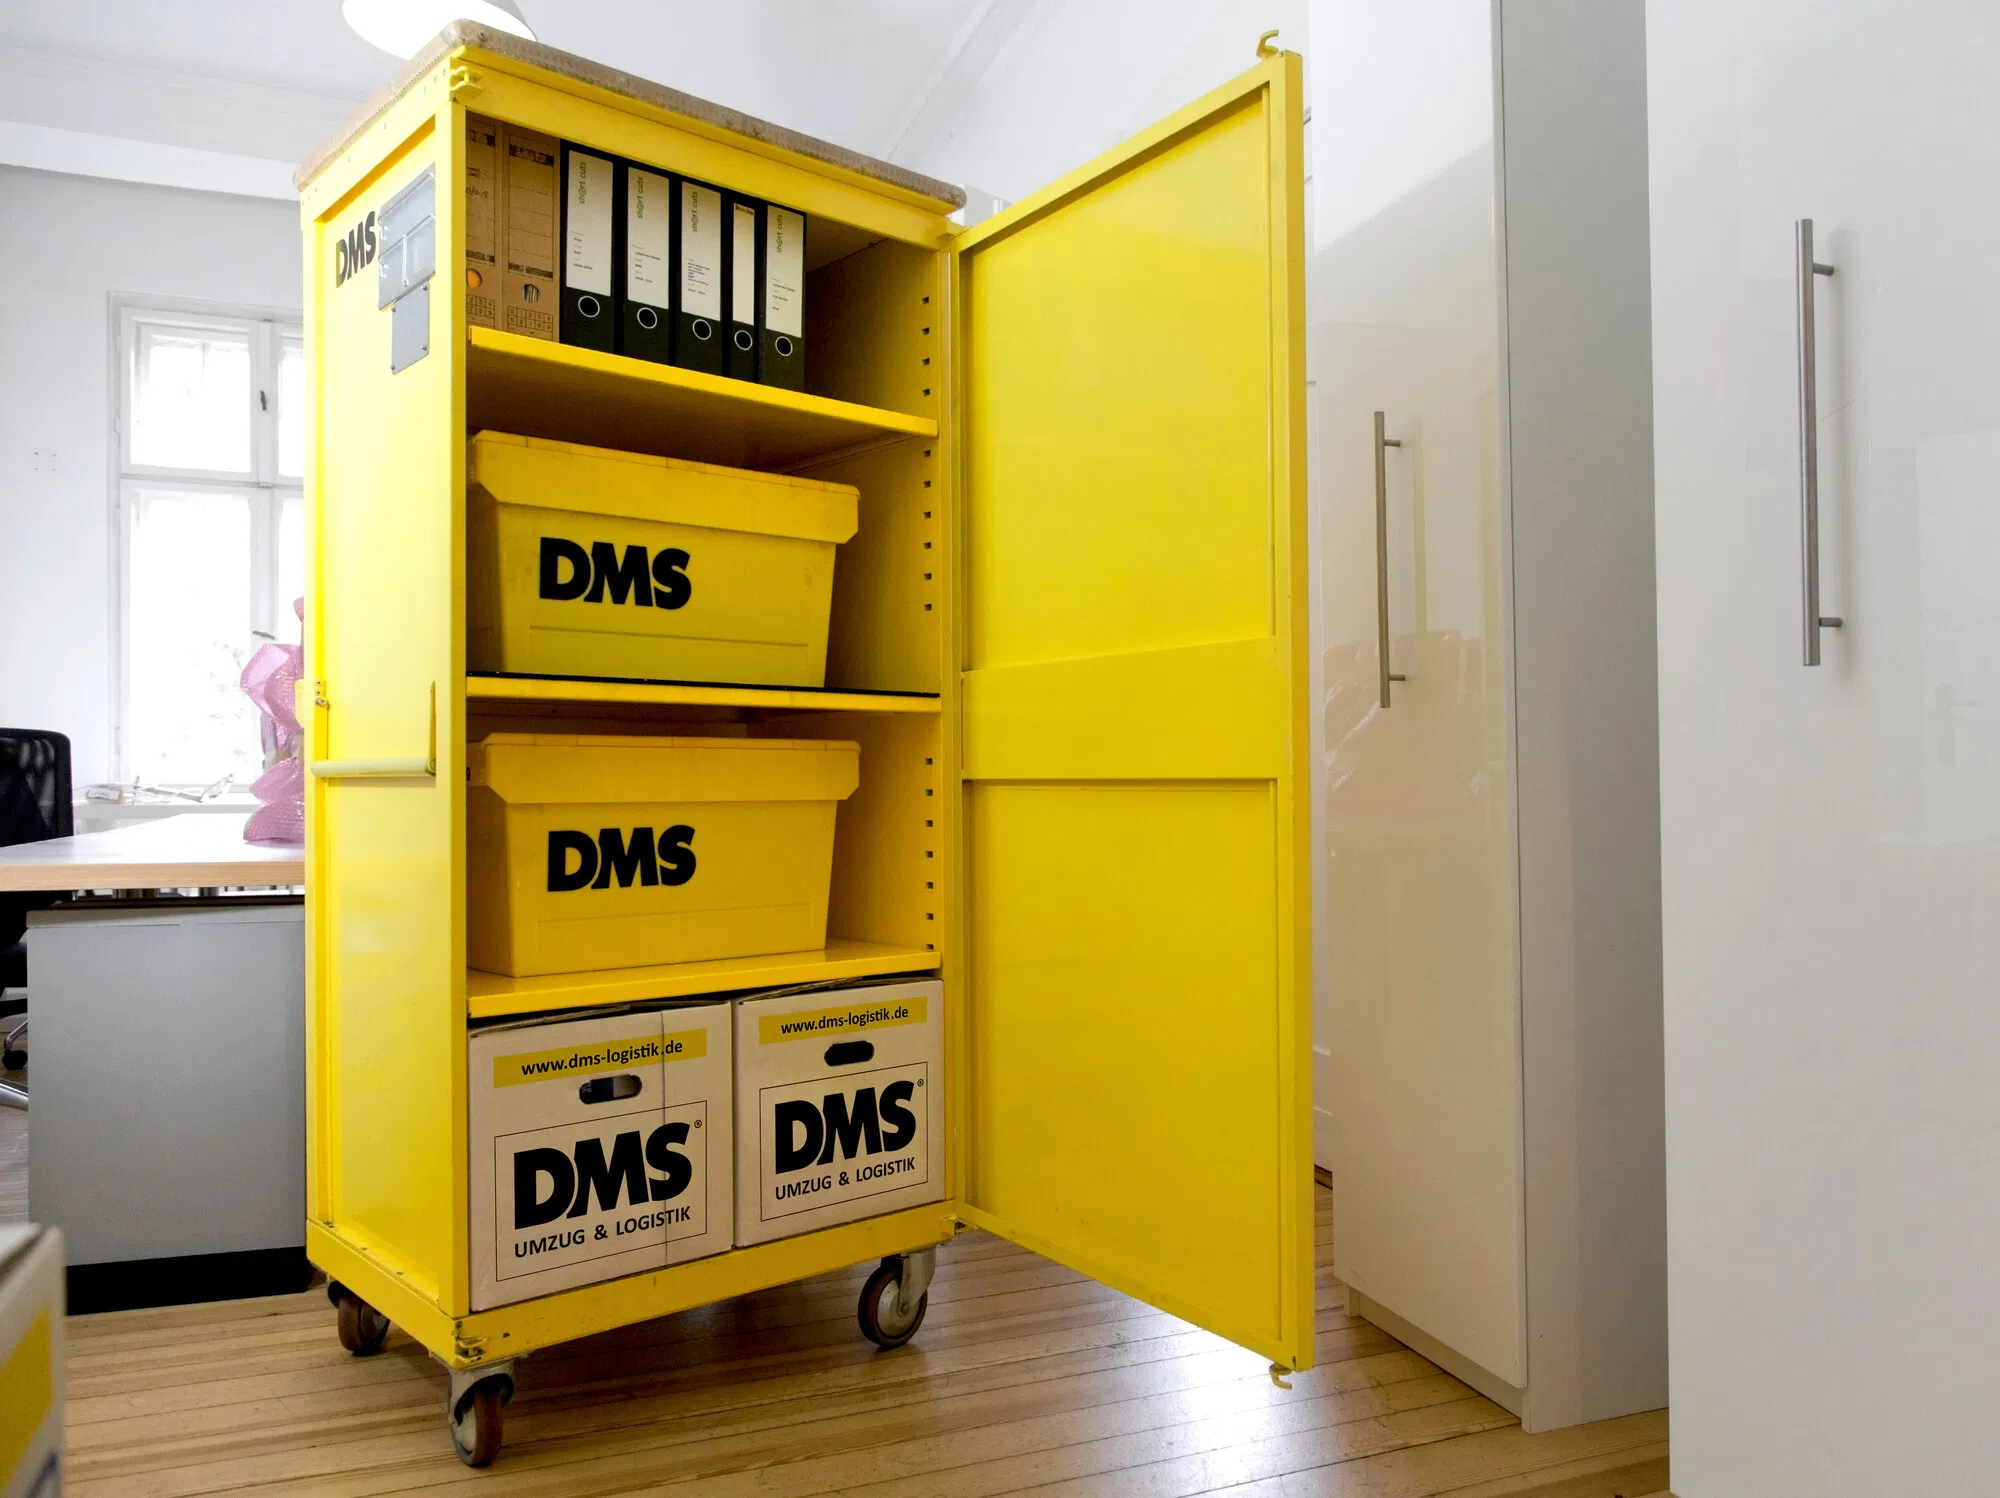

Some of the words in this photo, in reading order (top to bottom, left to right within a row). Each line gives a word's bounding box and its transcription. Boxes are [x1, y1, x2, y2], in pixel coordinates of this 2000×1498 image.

[335, 210, 377, 289] DMS
[539, 536, 692, 610] DMS
[547, 824, 697, 892] DMS
[780, 1006, 909, 1035] www.dms-logistik.de
[521, 1039, 683, 1076] www.dms-logistik.de
[775, 1175, 832, 1200] UMZUG
[838, 1171, 850, 1187] &
[856, 1156, 916, 1183] LOGISTIK
[514, 1229, 585, 1258] UMZUG
[593, 1223, 608, 1241] &
[616, 1205, 691, 1236] LOGISTIK
